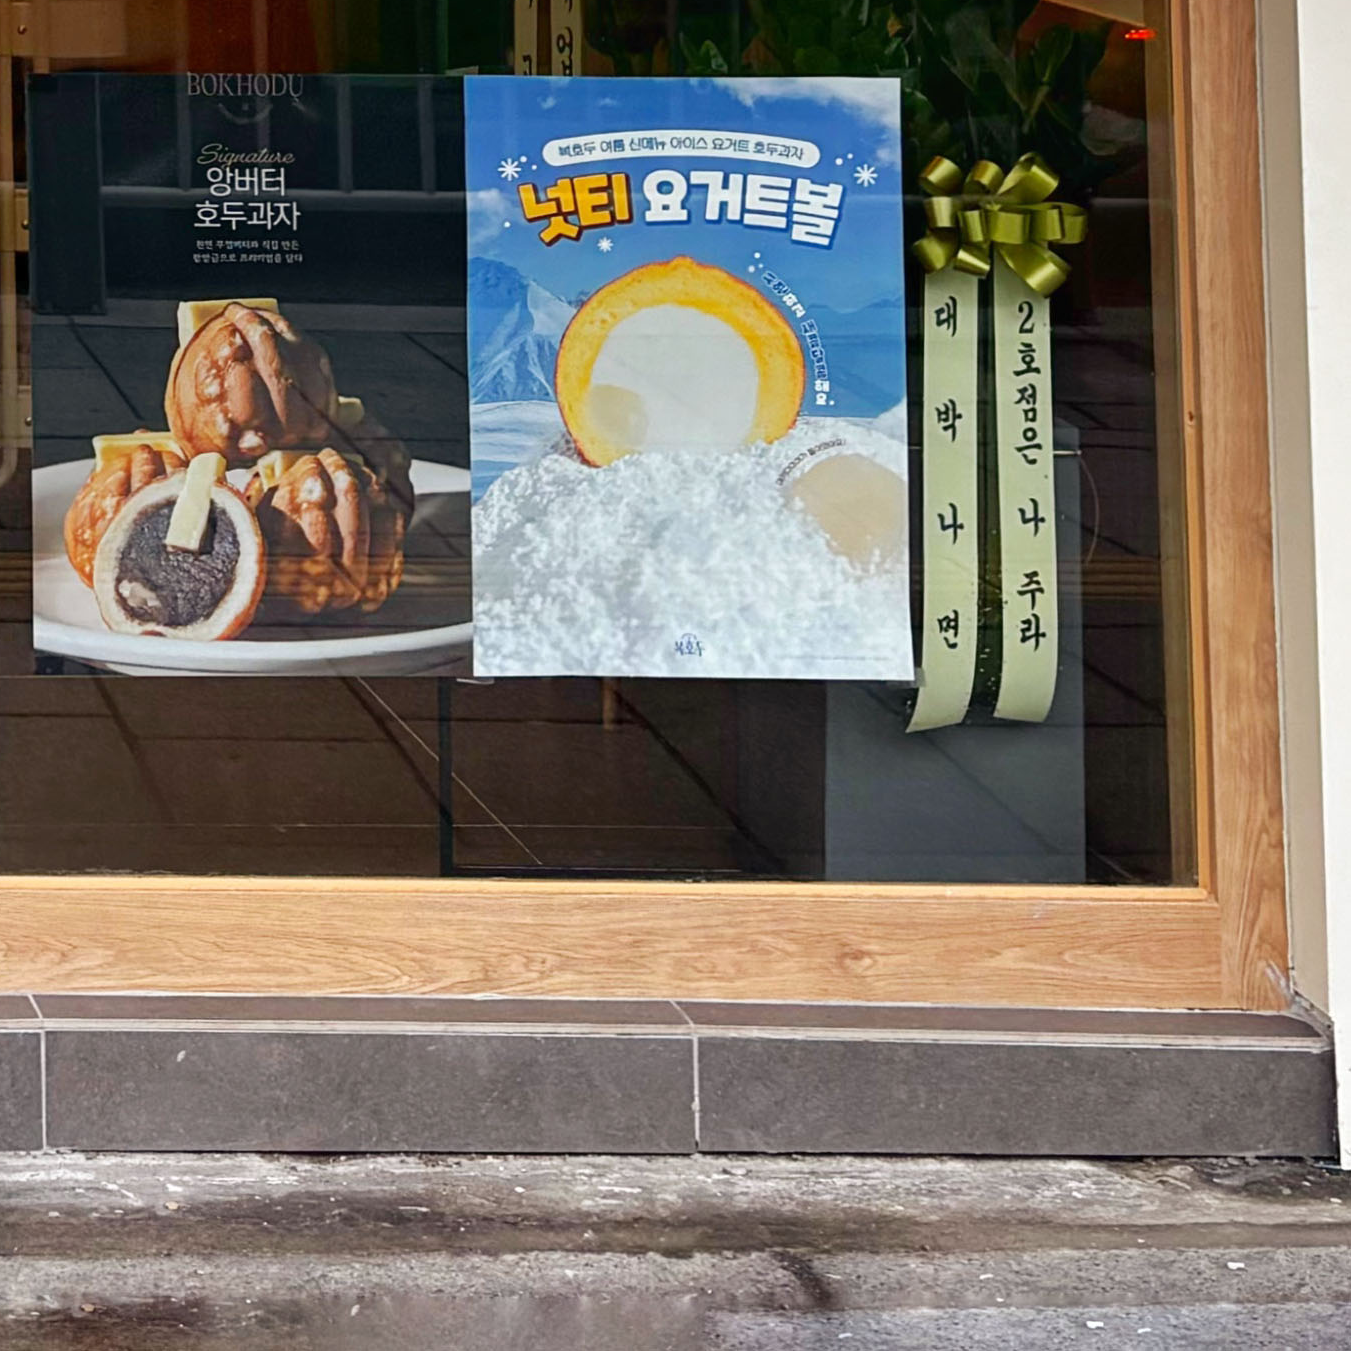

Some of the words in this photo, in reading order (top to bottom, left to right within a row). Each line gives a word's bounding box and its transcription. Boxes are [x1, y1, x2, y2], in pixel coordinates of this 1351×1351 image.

[186, 71, 304, 97] BOKHODU
[197, 144, 296, 167] Signature
[670, 136, 708, 150] 아이스
[206, 167, 286, 198] 앙버터
[193, 201, 301, 231] 호두과자
[517, 172, 634, 247] 넛티
[642, 169, 847, 249] 요거트볼
[1012, 301, 1043, 465] 2호점은
